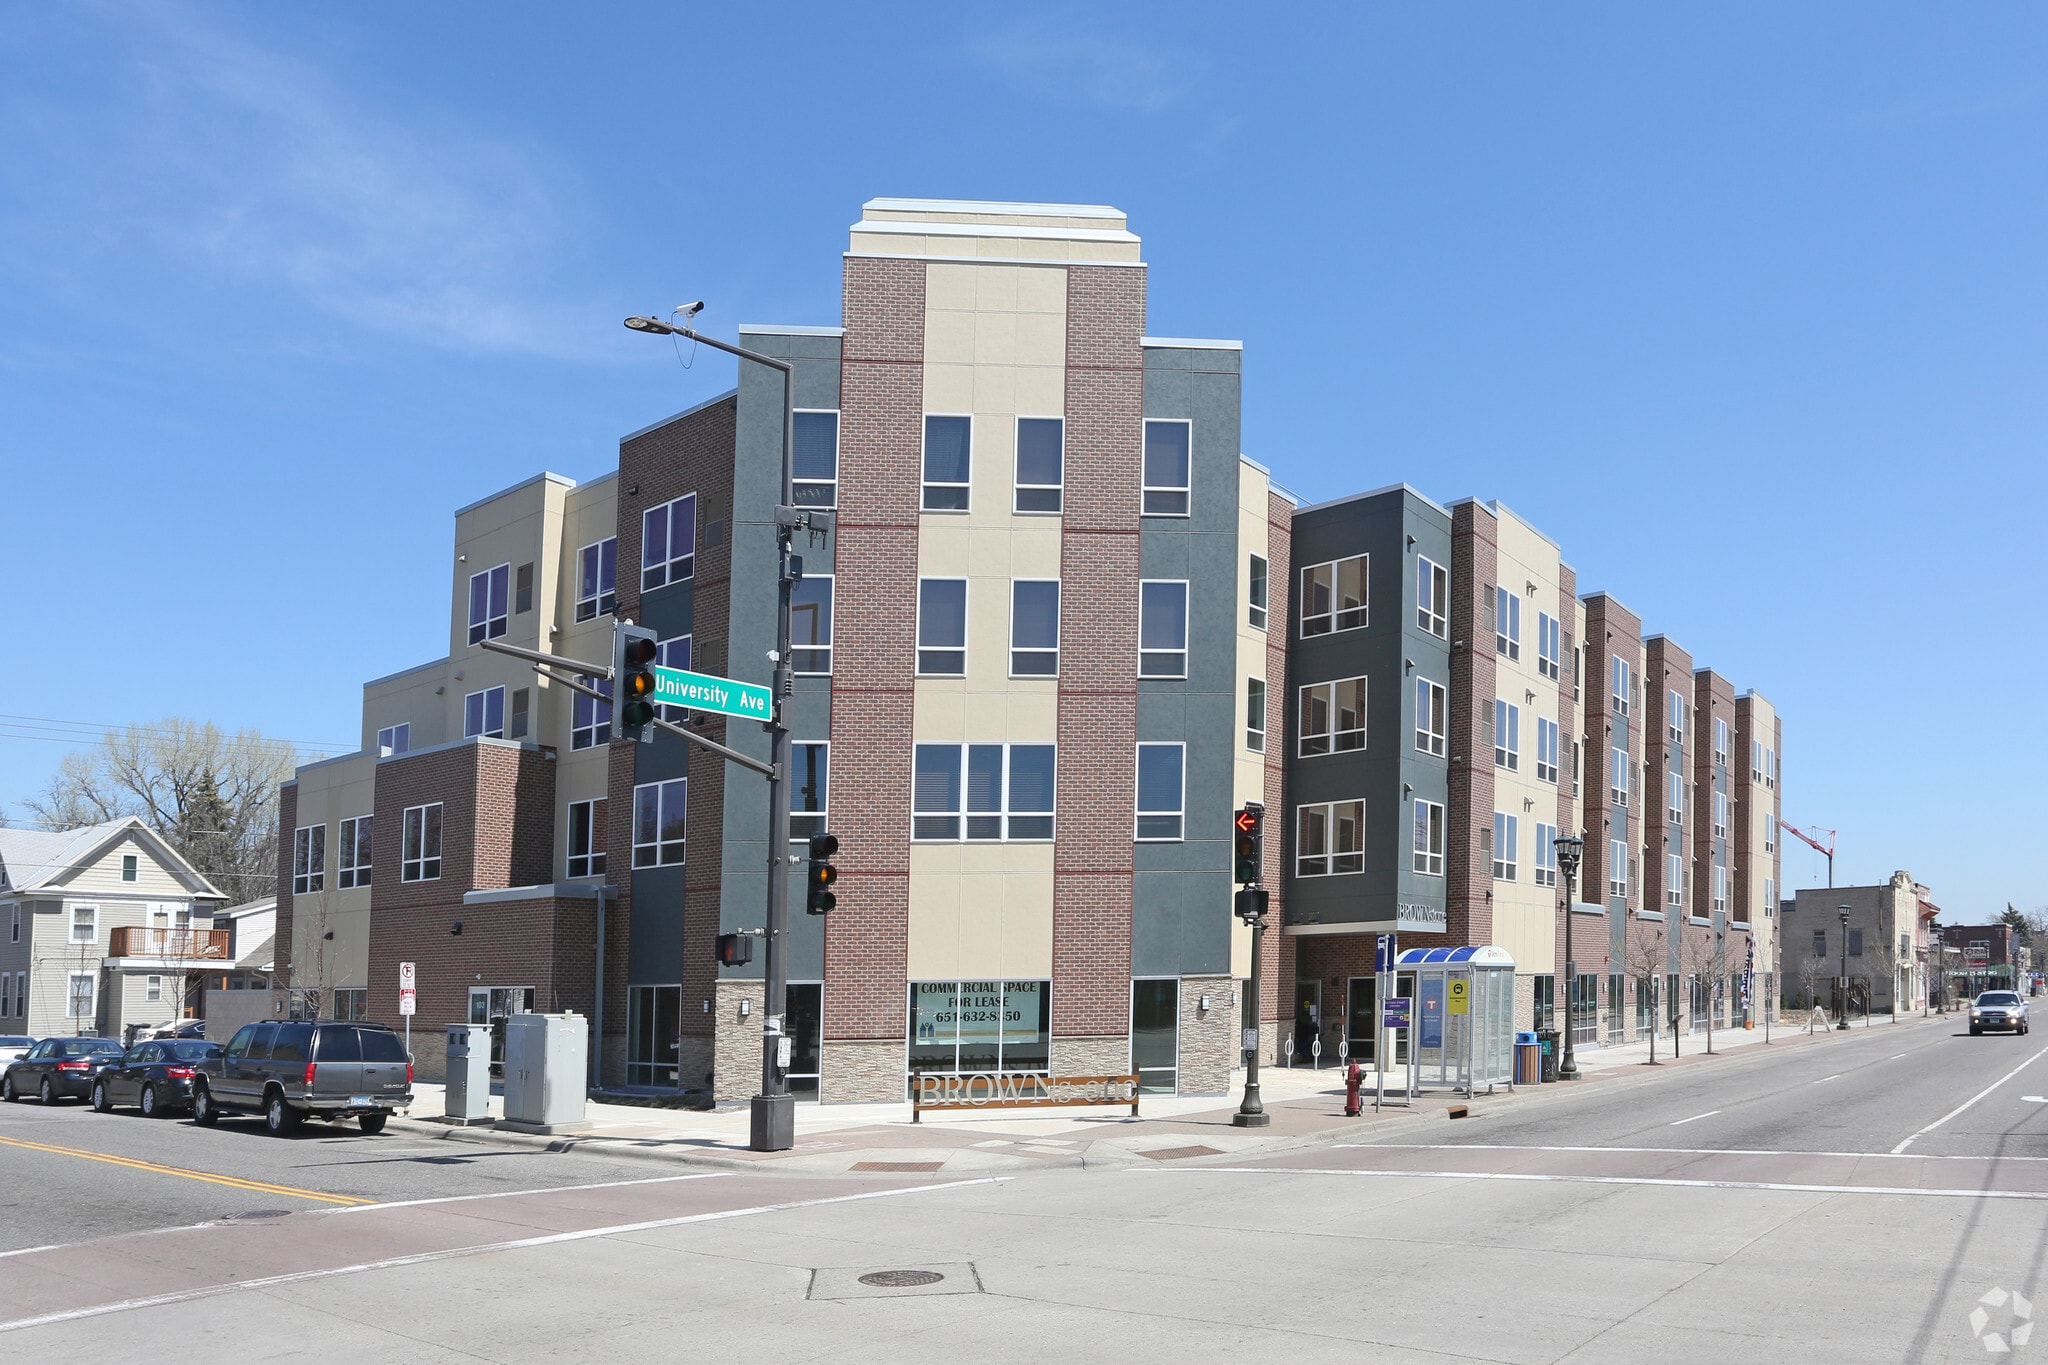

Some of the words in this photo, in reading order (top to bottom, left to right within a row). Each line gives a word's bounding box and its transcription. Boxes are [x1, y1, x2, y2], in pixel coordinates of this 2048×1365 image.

[656, 674, 729, 708] University
[740, 690, 764, 711] Ave
[1398, 903, 1447, 924] BROWNstone
[1002, 982, 1037, 993] SPACE
[948, 997, 971, 1008] FOR
[975, 996, 1009, 1008] LEASE
